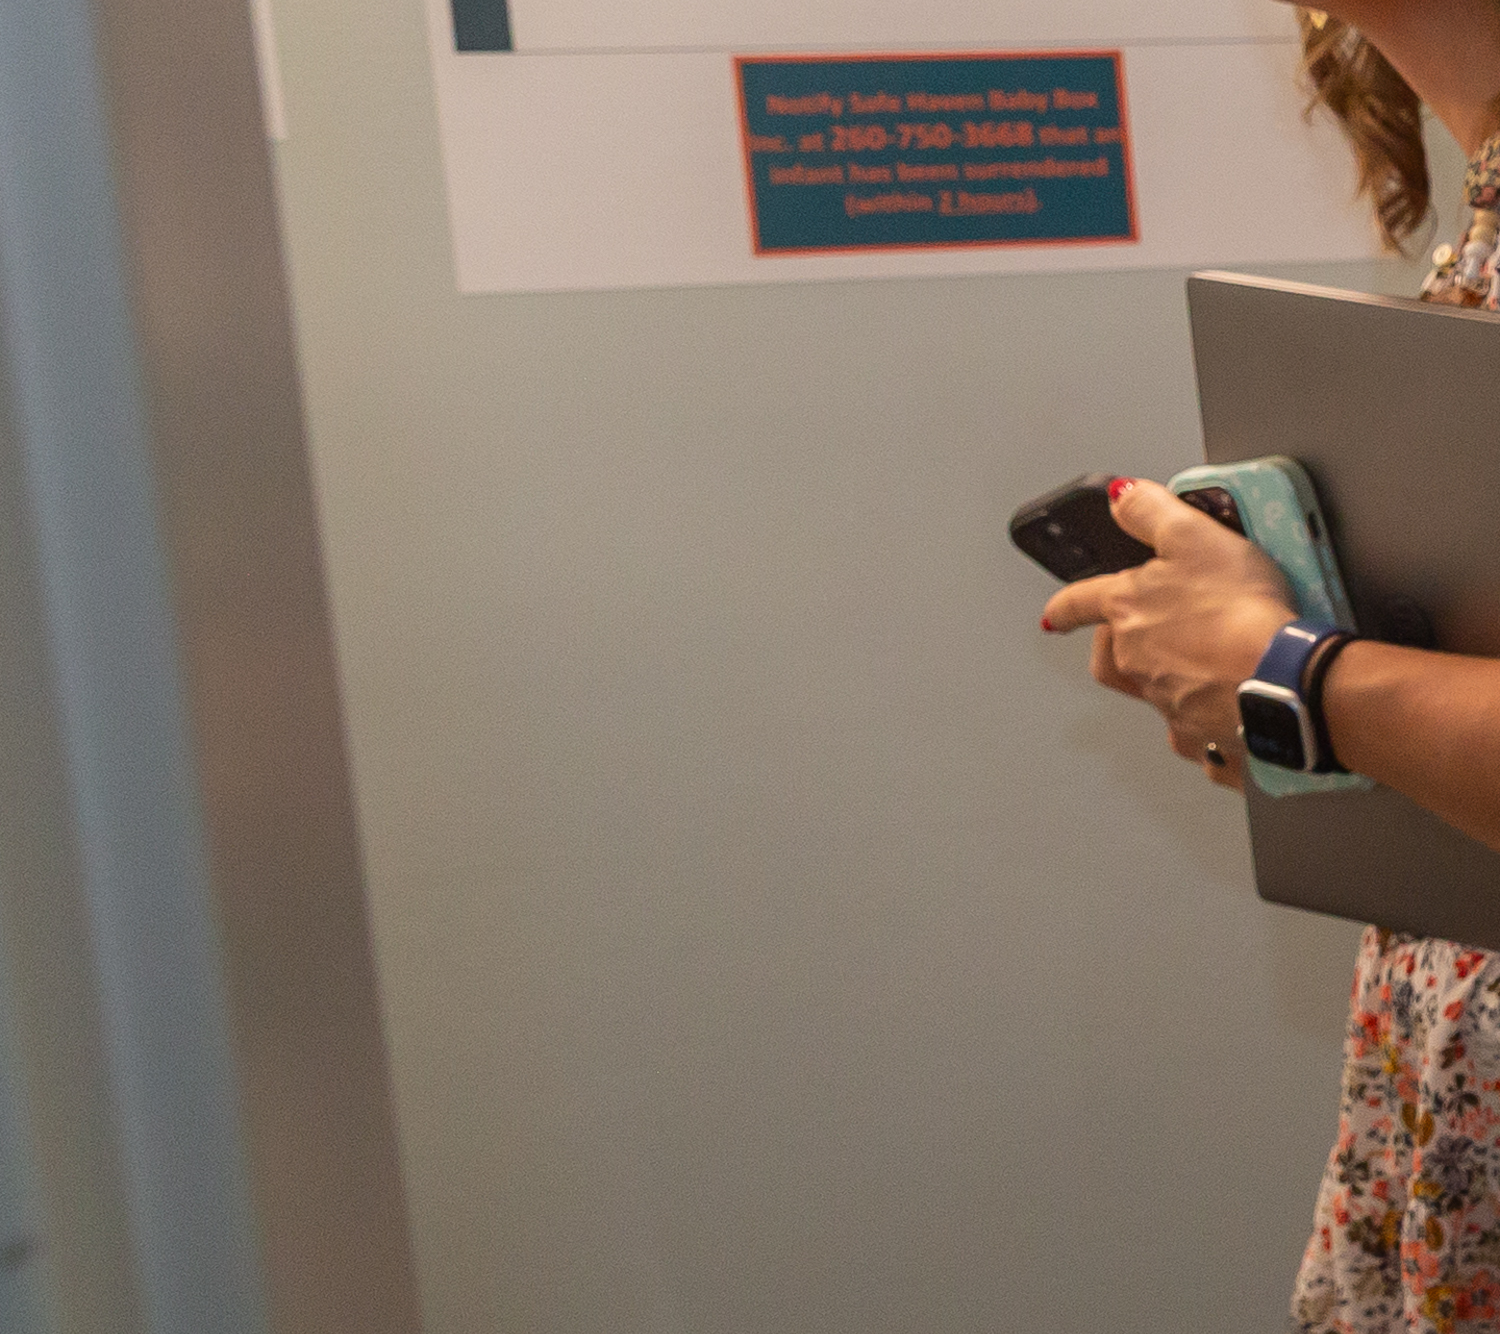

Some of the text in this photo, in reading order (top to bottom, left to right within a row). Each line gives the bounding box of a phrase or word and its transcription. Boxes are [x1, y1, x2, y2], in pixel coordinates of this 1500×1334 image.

[766, 87, 1098, 117] Notify Safe Haven Baby Box
[799, 131, 824, 152] at
[1038, 124, 1087, 146] that
[848, 161, 892, 183] has
[896, 162, 959, 182] been
[962, 156, 1110, 182] surrendered
[844, 190, 934, 218] (within
